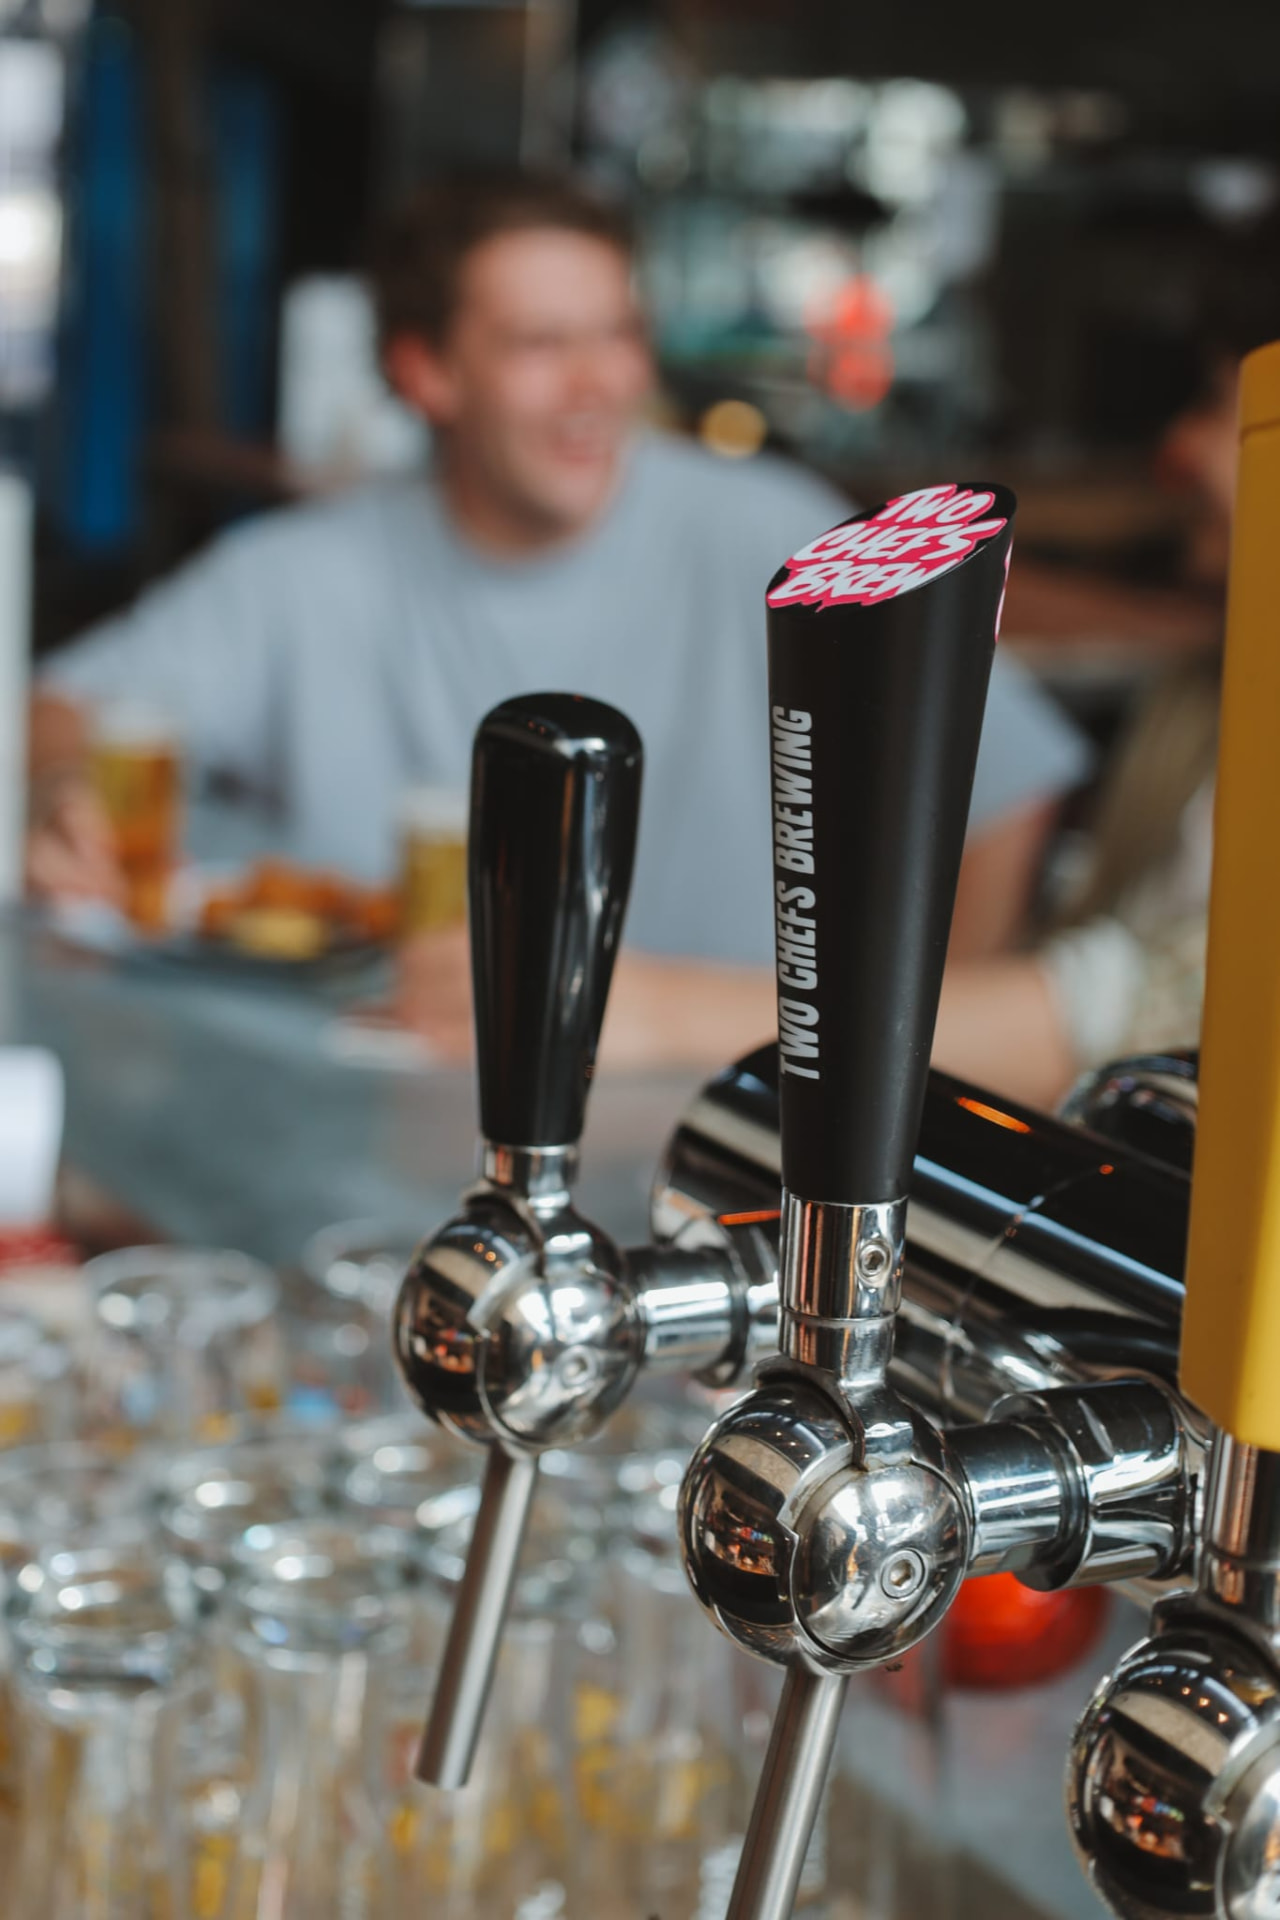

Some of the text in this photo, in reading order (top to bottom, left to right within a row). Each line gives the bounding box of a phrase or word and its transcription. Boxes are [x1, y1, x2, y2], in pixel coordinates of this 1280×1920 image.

[876, 484, 996, 524] TWO
[790, 517, 1008, 563] CHEFS
[766, 559, 960, 602] BREW
[772, 705, 821, 1081] TWO CHEFS BREWING
